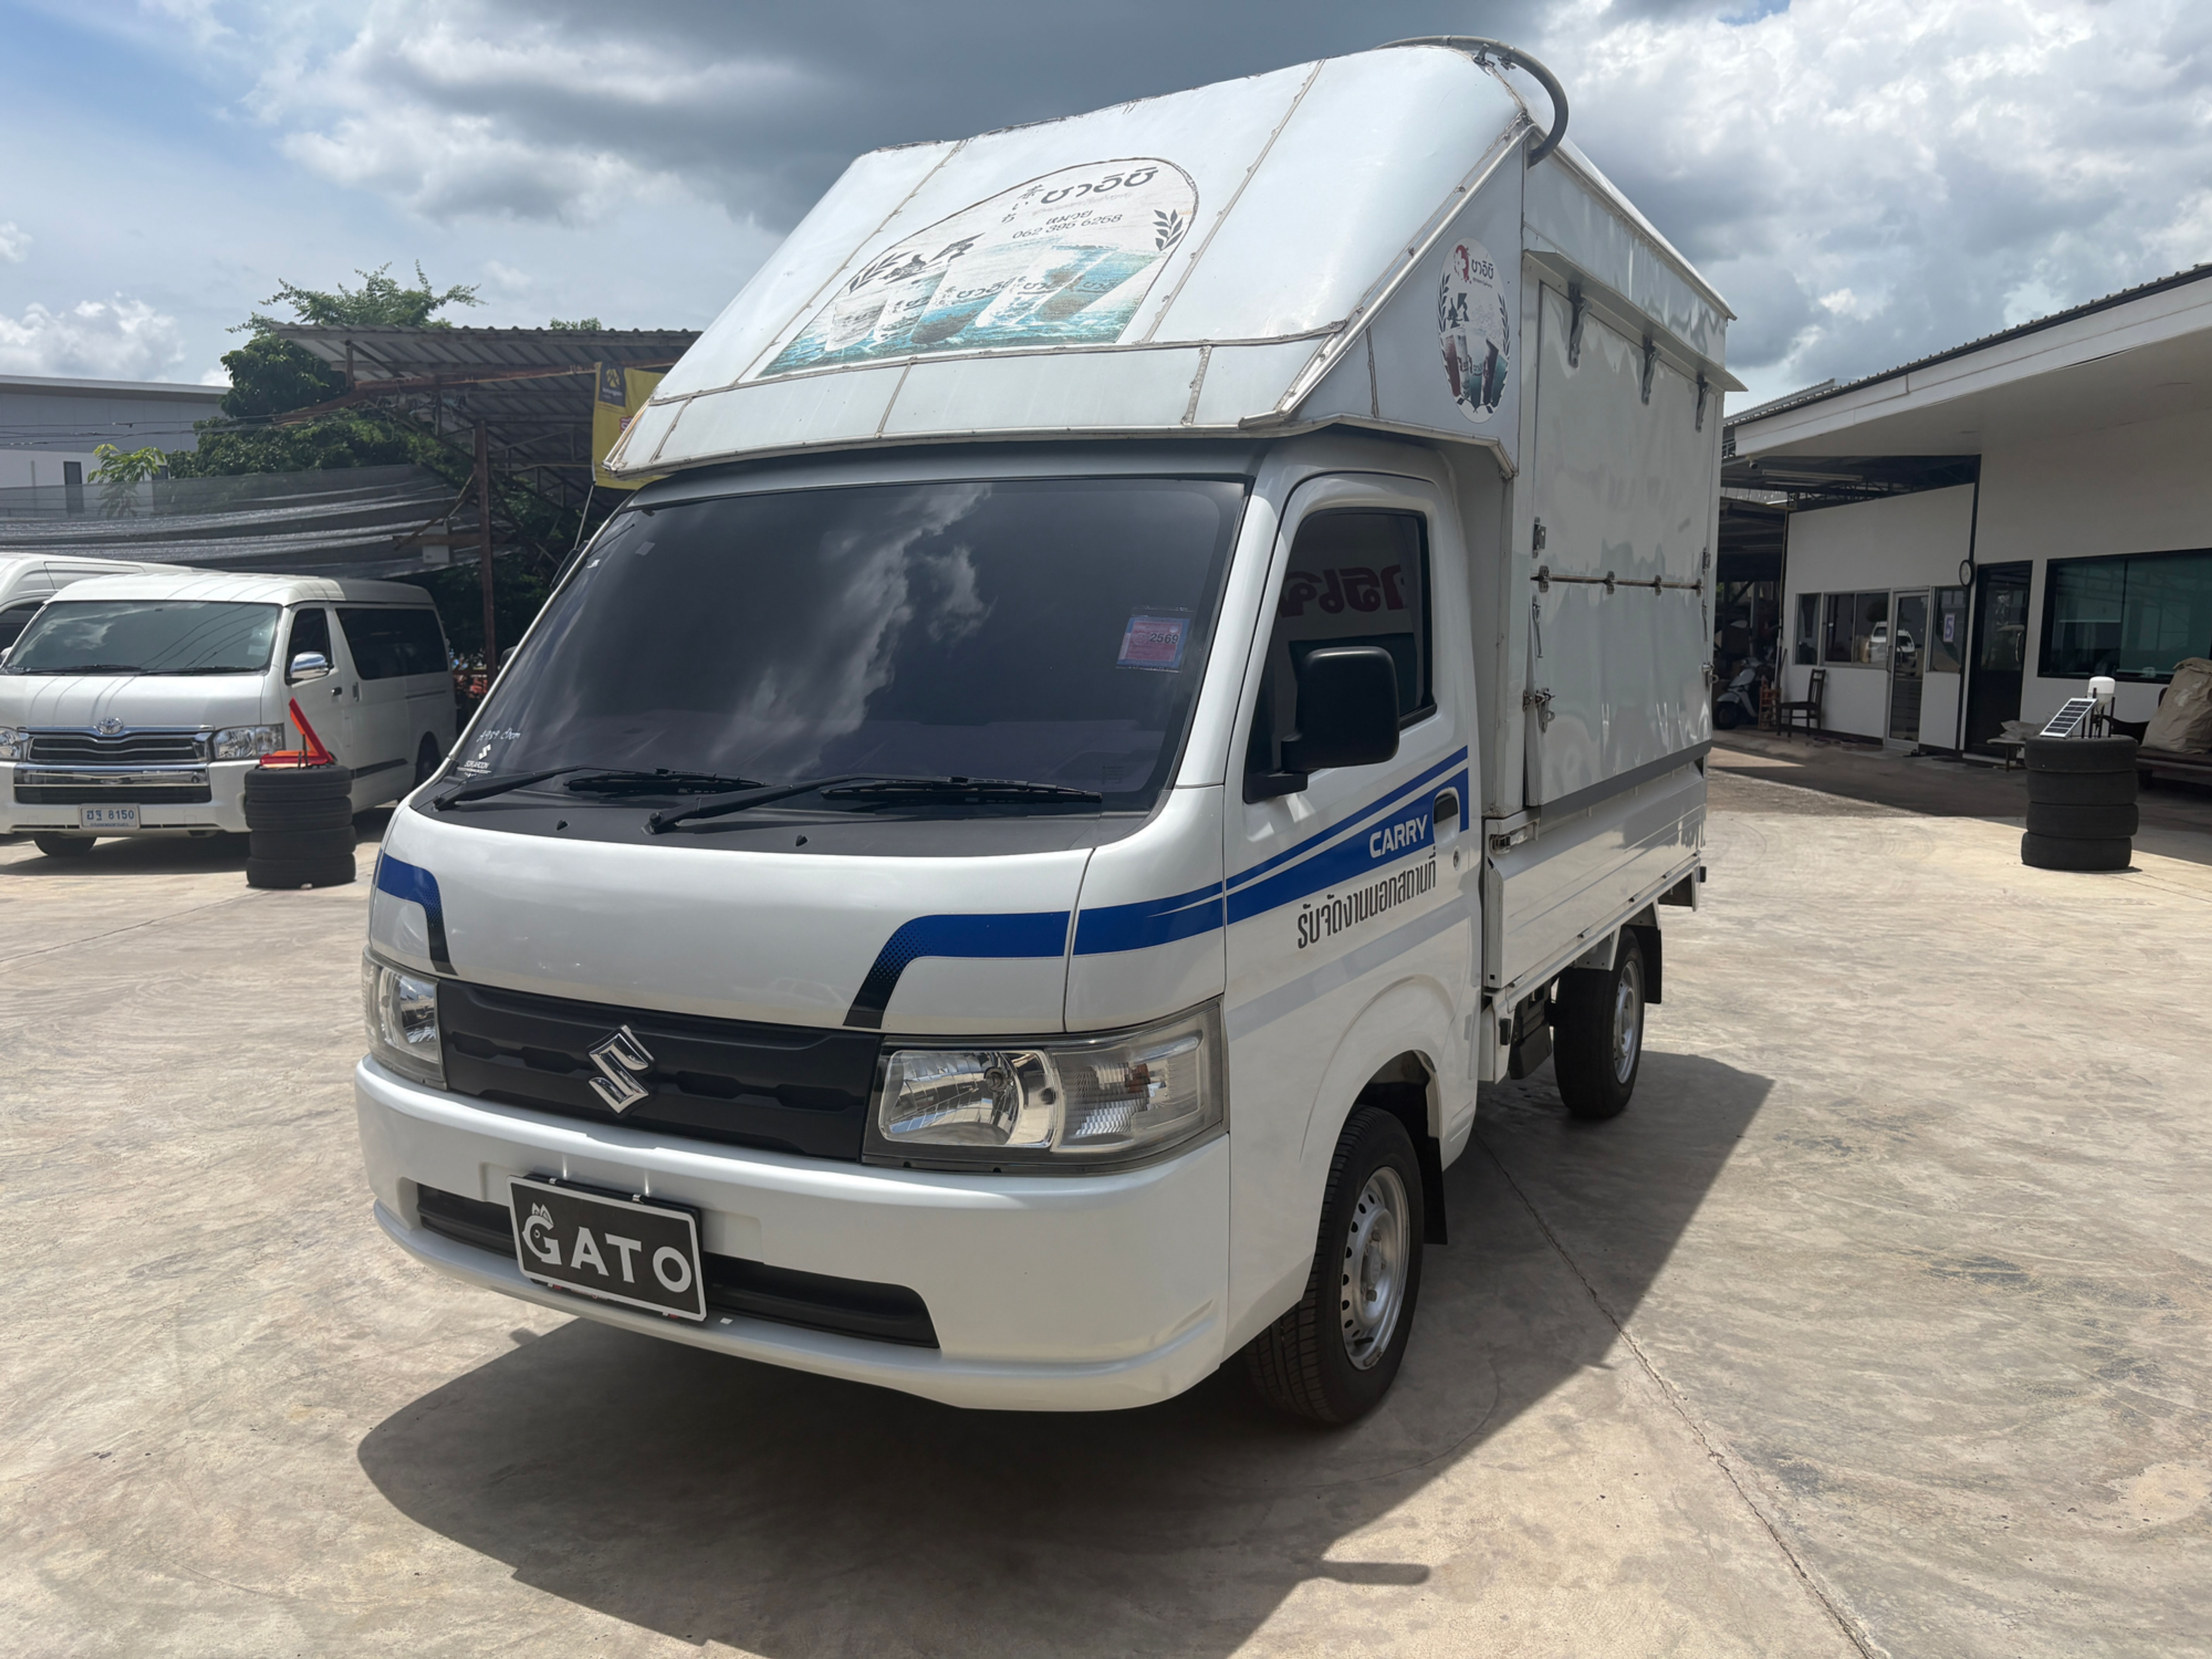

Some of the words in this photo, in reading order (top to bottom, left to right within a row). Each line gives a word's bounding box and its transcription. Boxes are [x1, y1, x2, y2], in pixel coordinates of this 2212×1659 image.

[1012, 227, 1043, 239] 062
[1149, 633, 1179, 644] 2569
[108, 809, 134, 819] 8150
[1369, 814, 1427, 859] CARRY
[1297, 845, 1436, 949] รับจัดงานนอกสถานที่
[522, 1203, 692, 1293] GATO
